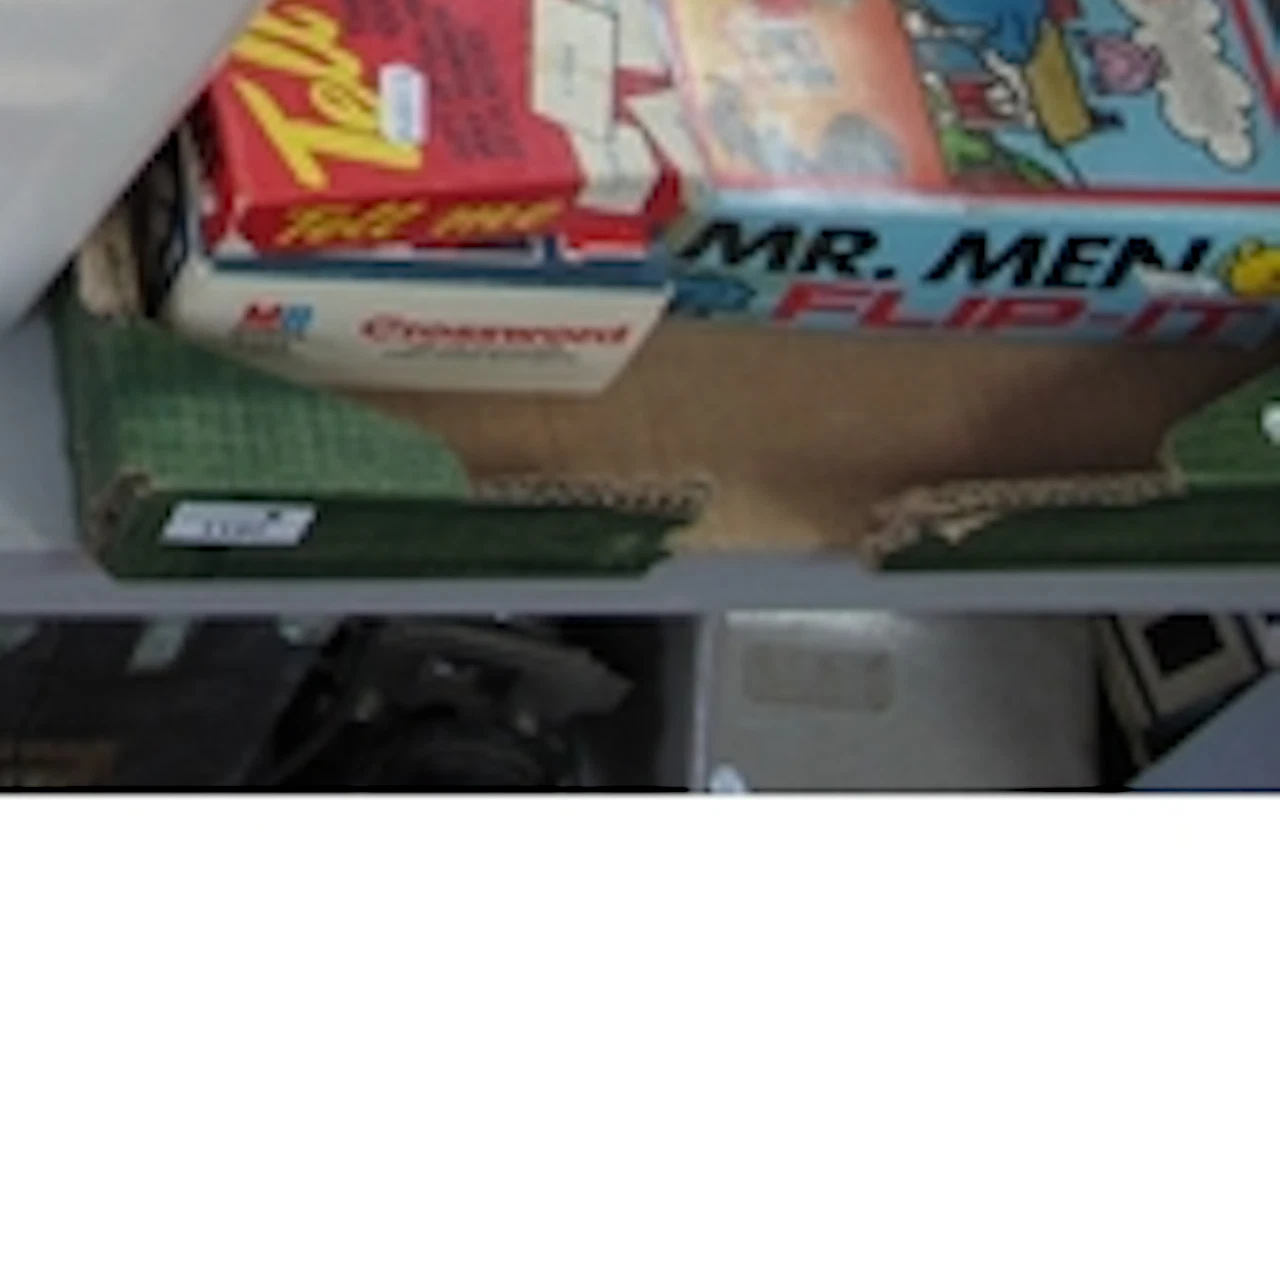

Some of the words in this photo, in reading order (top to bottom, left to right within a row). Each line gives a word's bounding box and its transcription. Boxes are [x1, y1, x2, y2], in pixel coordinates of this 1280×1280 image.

[678, 220, 899, 280] MR.
[924, 228, 1212, 291] MEN
[359, 313, 631, 347] Crossword
[768, 280, 1264, 340] FLIP-IT
